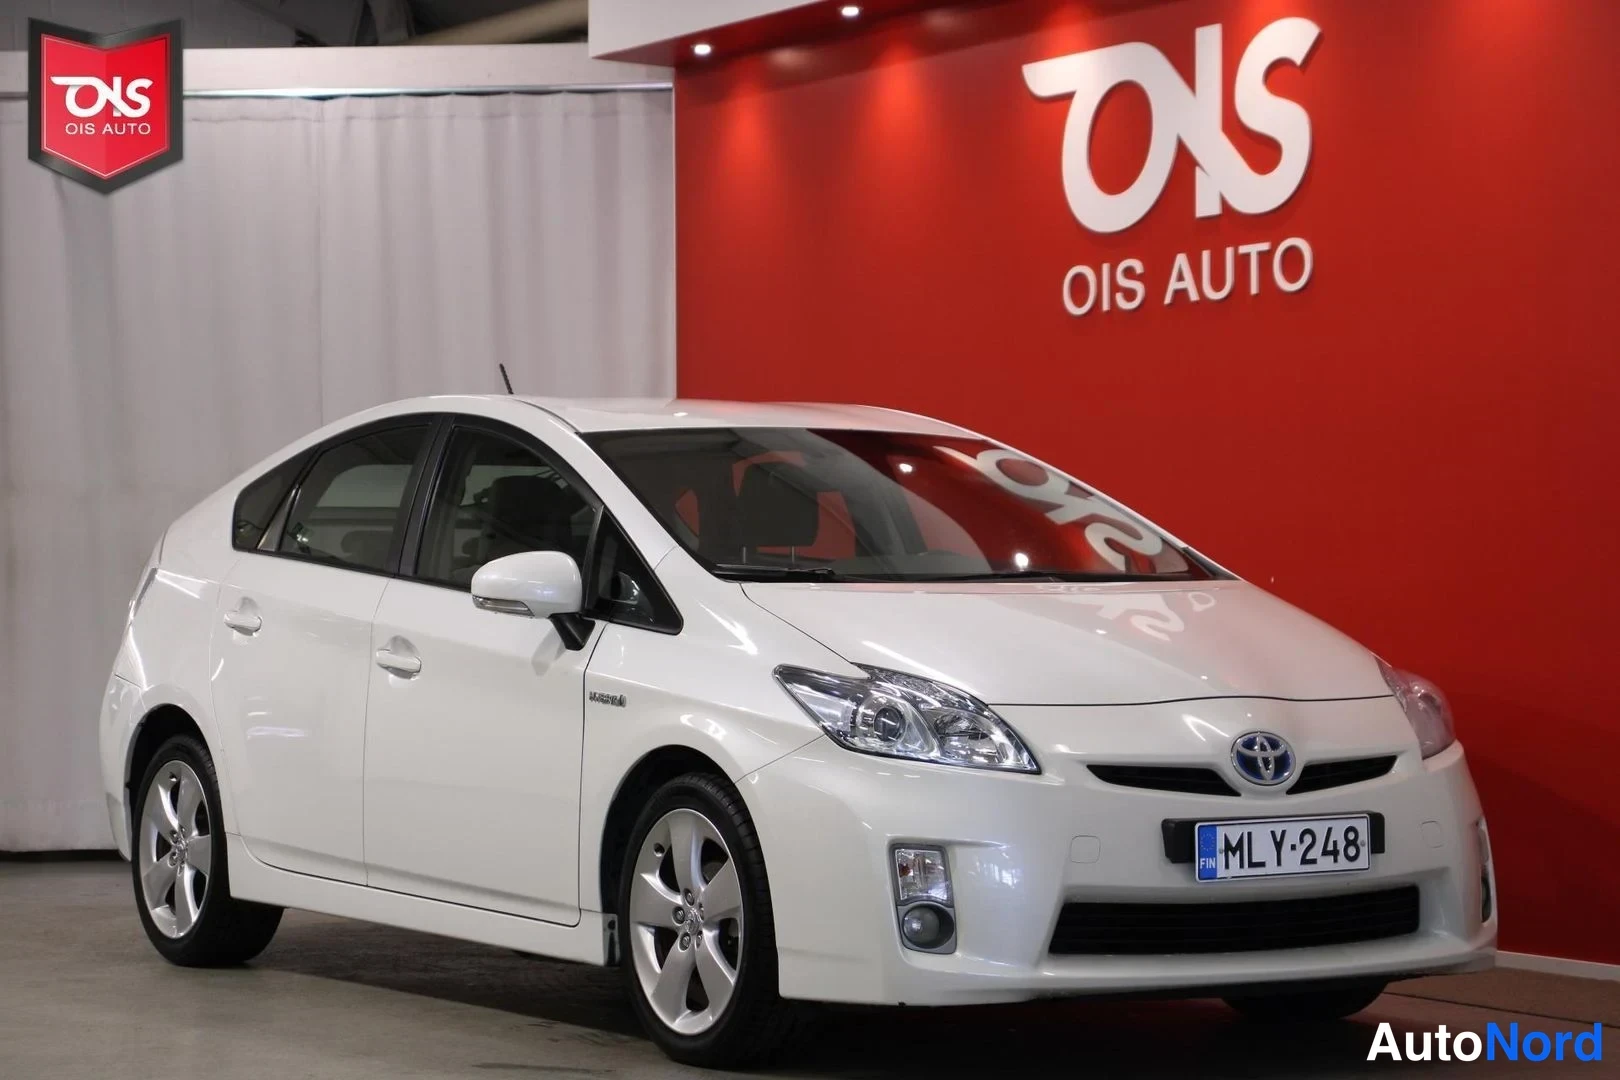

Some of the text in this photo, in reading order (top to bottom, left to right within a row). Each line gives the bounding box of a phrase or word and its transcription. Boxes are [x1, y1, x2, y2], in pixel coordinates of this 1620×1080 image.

[1022, 17, 1320, 233] OIS
[1062, 237, 1313, 316] OIS AUTO
[1200, 857, 1216, 869] FIN
